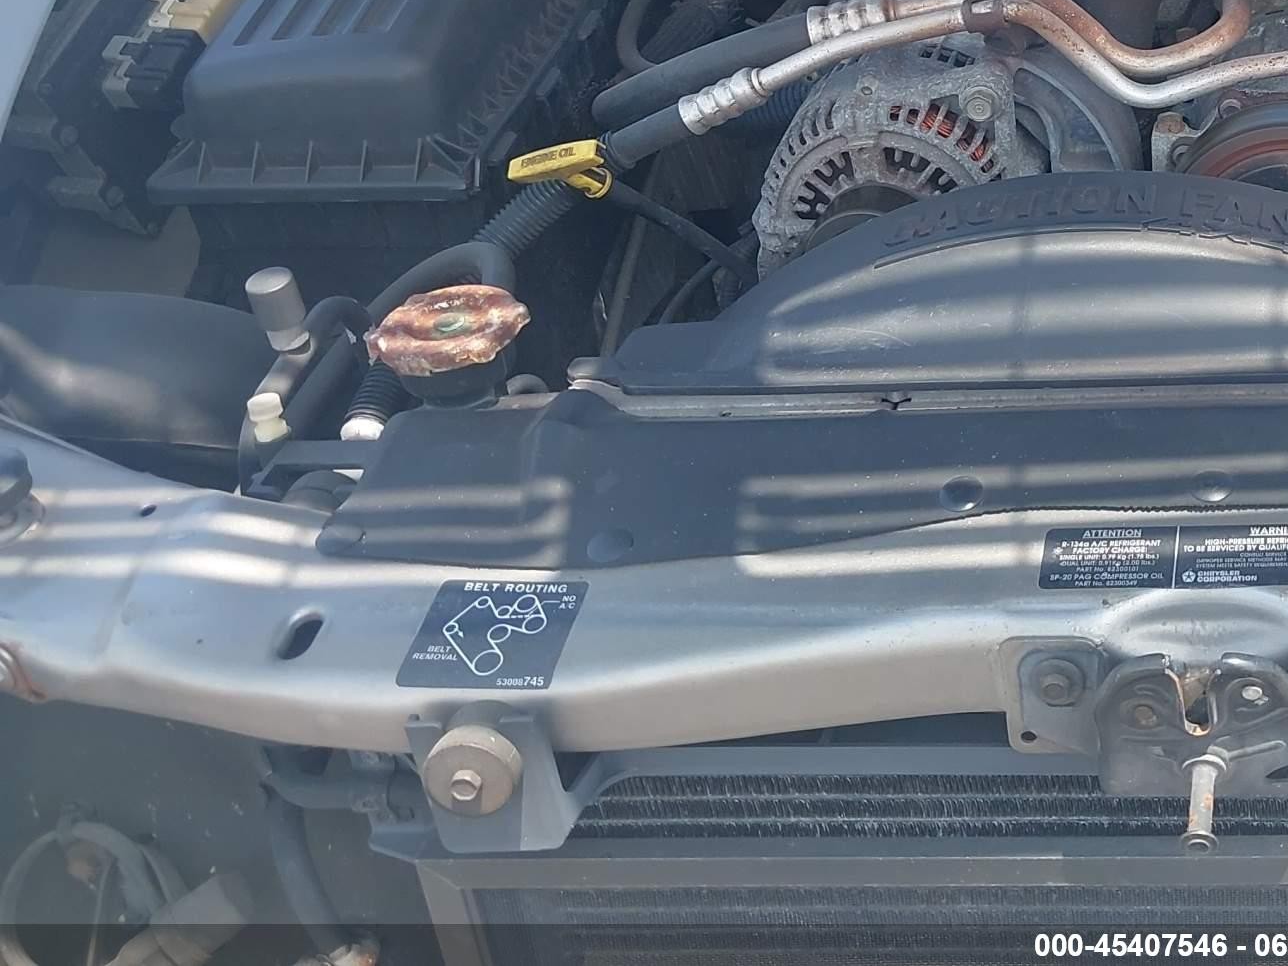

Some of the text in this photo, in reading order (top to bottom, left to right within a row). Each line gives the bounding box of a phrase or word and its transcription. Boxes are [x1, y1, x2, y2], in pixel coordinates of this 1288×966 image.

[521, 147, 577, 167] ENGINE OIL
[1083, 529, 1142, 538] ATTENTION
[464, 582, 568, 593] BELT ROUTING
[412, 653, 458, 661] REMOVAL
